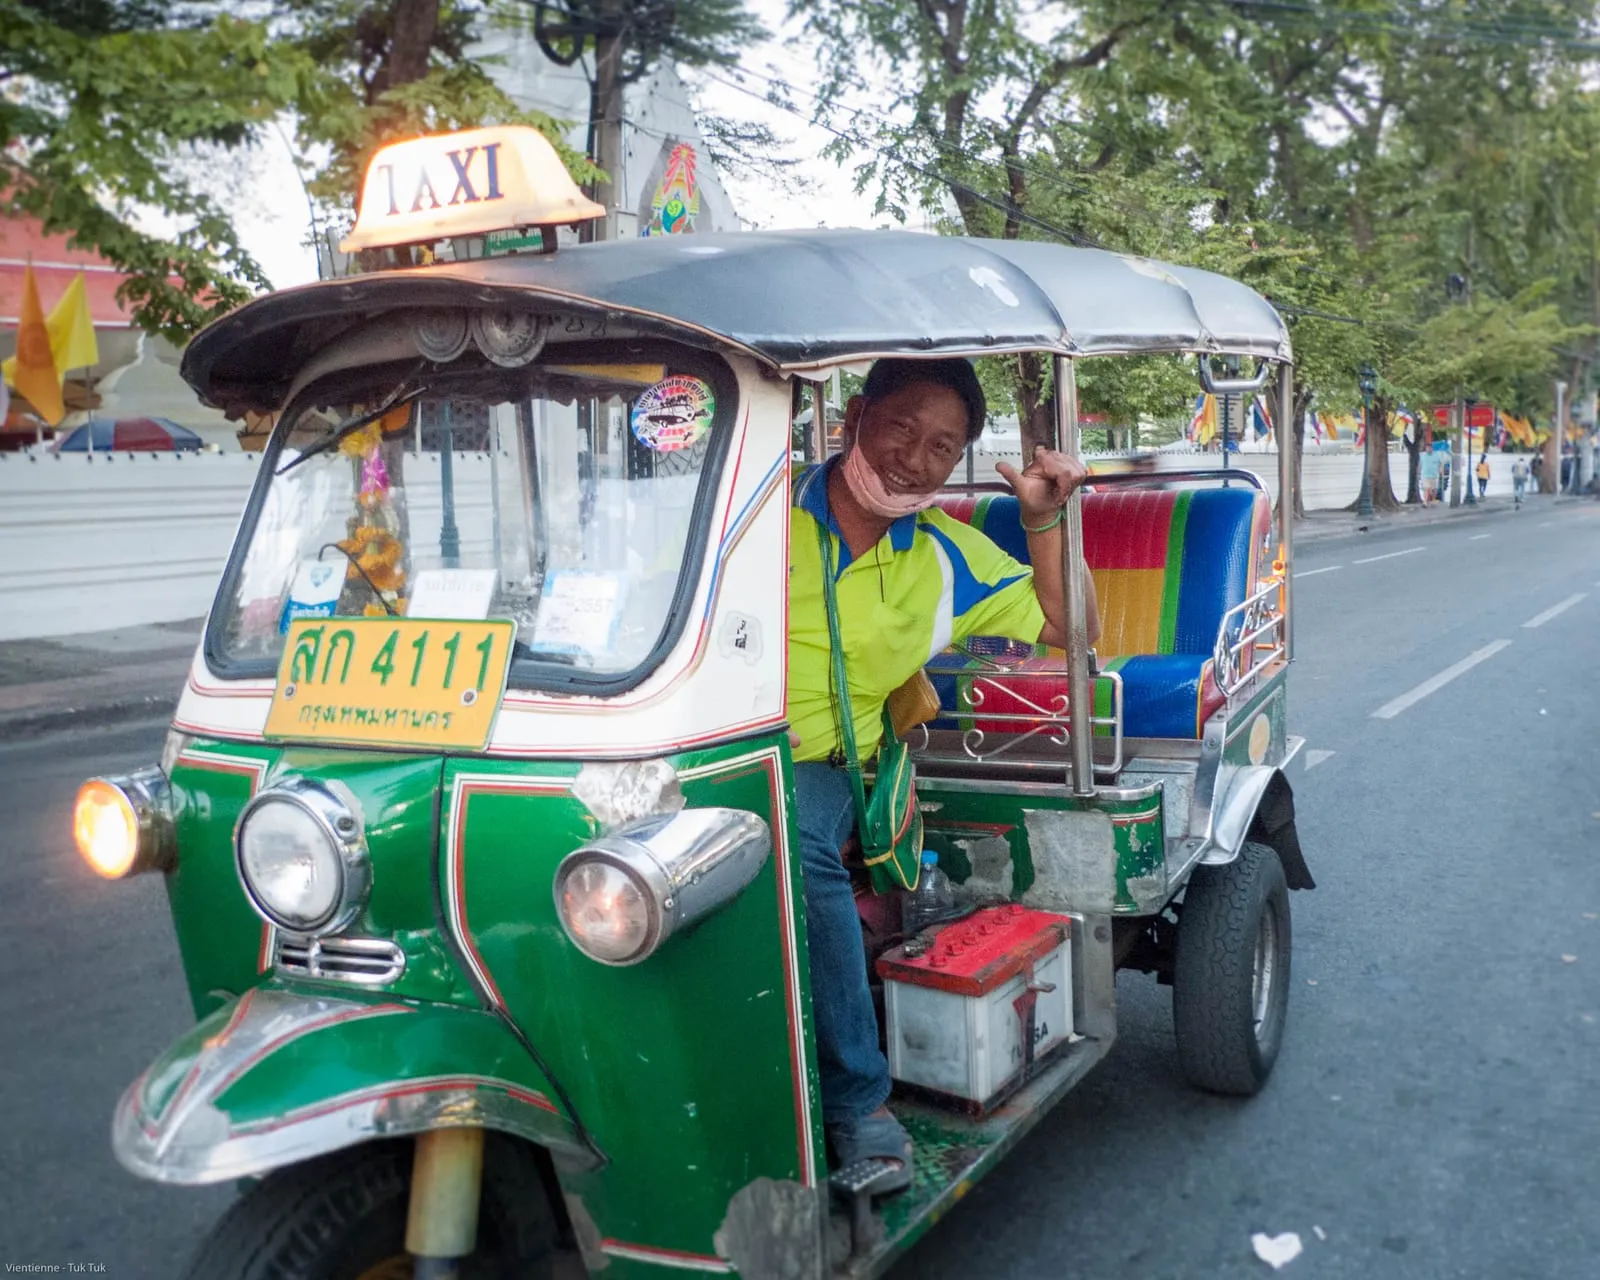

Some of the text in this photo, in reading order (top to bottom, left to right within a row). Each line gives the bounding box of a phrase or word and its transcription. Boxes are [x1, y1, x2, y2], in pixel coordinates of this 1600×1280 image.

[377, 142, 505, 217] TAXI
[290, 624, 495, 692] สก 4111
[299, 704, 454, 732] กรุงเทพมหานคร
